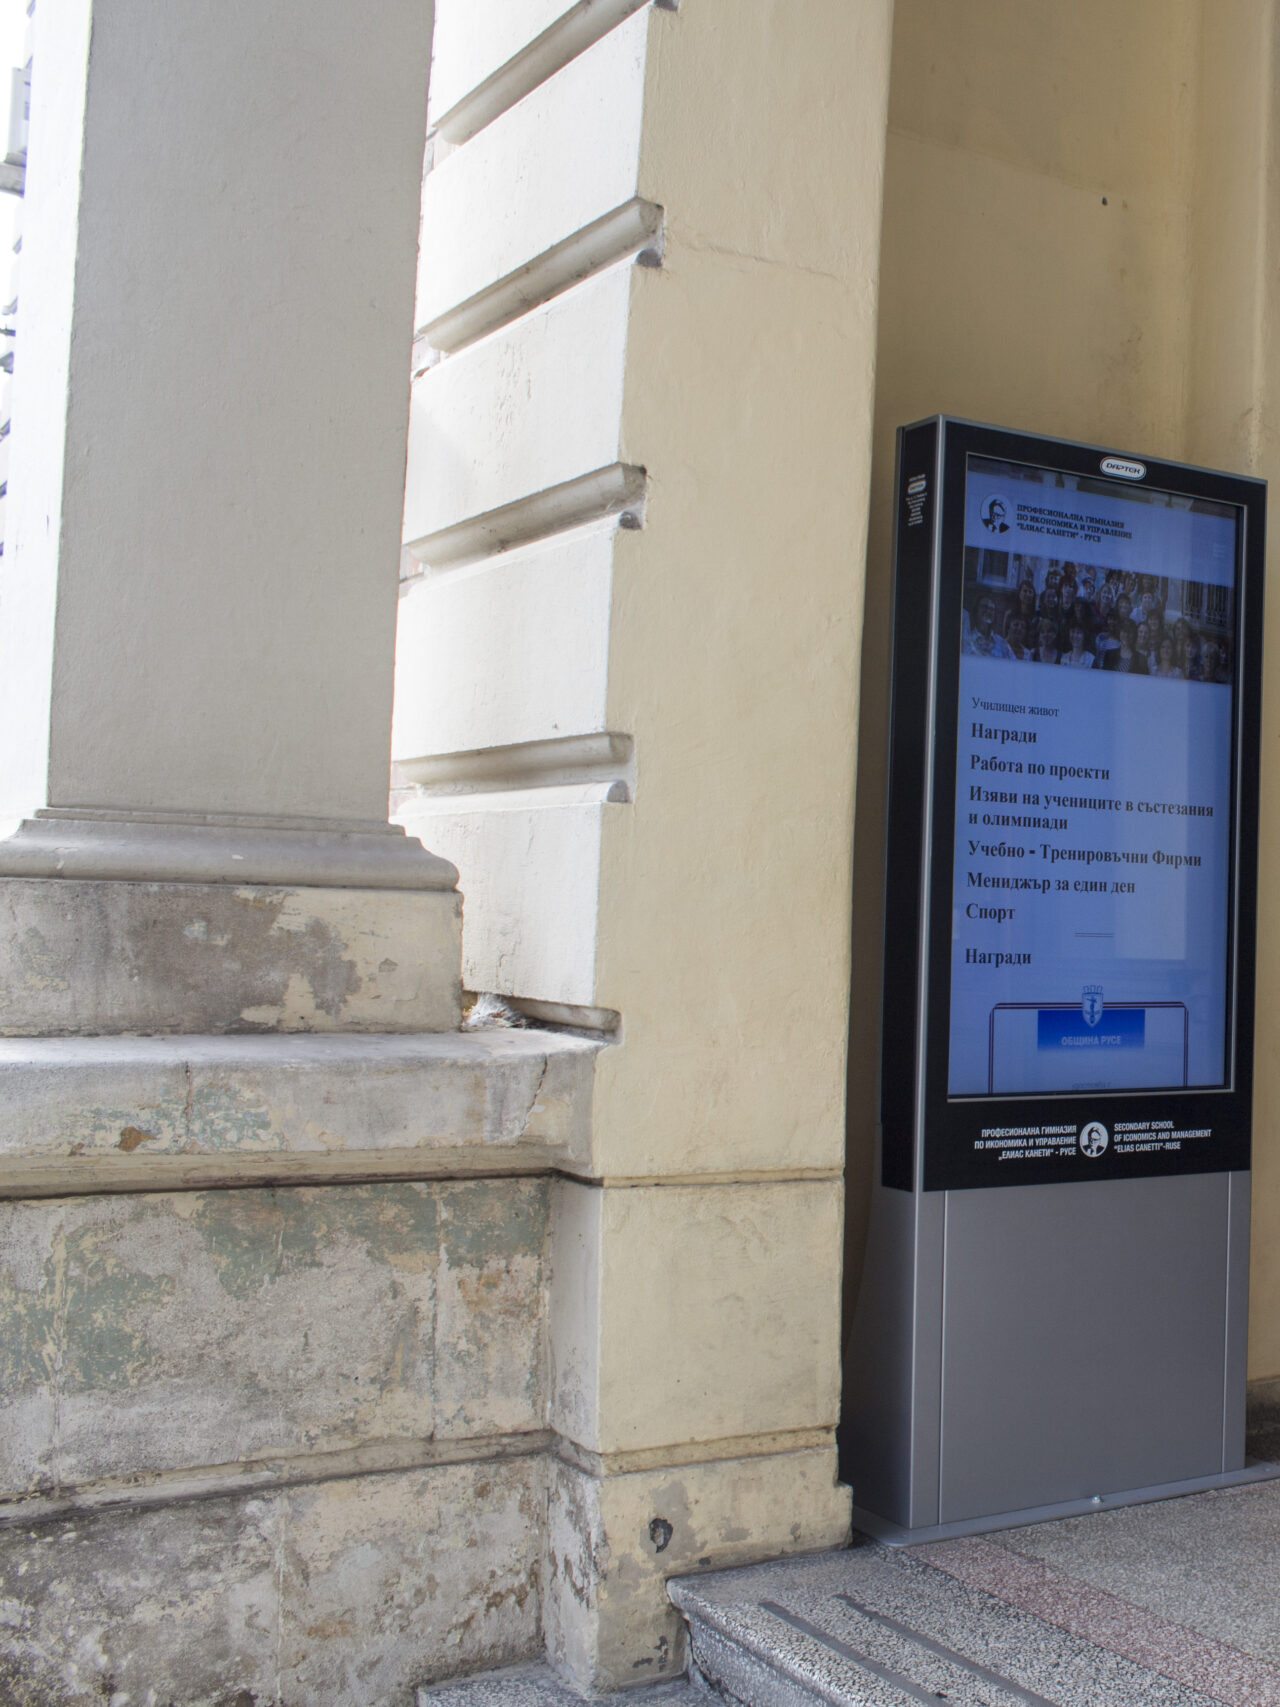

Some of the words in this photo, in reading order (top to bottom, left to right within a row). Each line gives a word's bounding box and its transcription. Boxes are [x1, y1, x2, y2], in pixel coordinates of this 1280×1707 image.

[1016, 513, 1028, 522] ПО
[1017, 504, 1084, 522] ПРОФЕСИОНАЛНА
[1085, 514, 1125, 529] ГИМНАЗИЯ
[1084, 533, 1101, 543] РУСЕ
[971, 697, 1026, 715] Училищен
[1028, 706, 1060, 718] живот
[970, 722, 1038, 744] Награди
[969, 754, 1023, 774] Работа
[1027, 762, 1045, 776] по
[1050, 764, 1111, 781] проекти
[969, 785, 1018, 804] Изяви
[1022, 792, 1040, 806] на
[1043, 794, 1122, 812] учениците
[1125, 800, 1134, 812] в
[1137, 800, 1214, 818] състезания
[968, 812, 978, 825] и
[982, 813, 1068, 831] олимпиади
[967, 840, 1025, 859] Учебно
[1040, 843, 1149, 866] Тренировъчни
[1152, 850, 1202, 869] Фирми
[967, 871, 1051, 892] Мениджър
[1054, 879, 1070, 892] за
[1073, 879, 1108, 893] един
[1111, 880, 1136, 894] ден
[966, 902, 1016, 923] Спорт
[965, 948, 1032, 968] Награди
[1061, 1035, 1099, 1047] ОБЩИНА
[1101, 1034, 1121, 1046] РУСЕ
[981, 1126, 1040, 1138] ПРОФЕСИОНАЛНА
[1041, 1124, 1077, 1135] ГИМНАЗИЯ
[1114, 1121, 1150, 1132] SECONDARY
[1151, 1120, 1175, 1130] SCHOOL
[1114, 1133, 1122, 1142] OF
[1123, 1131, 1153, 1142] ICONOMICS
[1153, 1131, 1170, 1140] AND
[1171, 1129, 1212, 1139] MANAGEMENT
[974, 1140, 985, 1150] ПО
[985, 1138, 1027, 1149] ИКОНОМИКА
[1035, 1135, 1077, 1147] УПРАВЛЕНИЕ
[1060, 1146, 1077, 1157] РУСЕ
